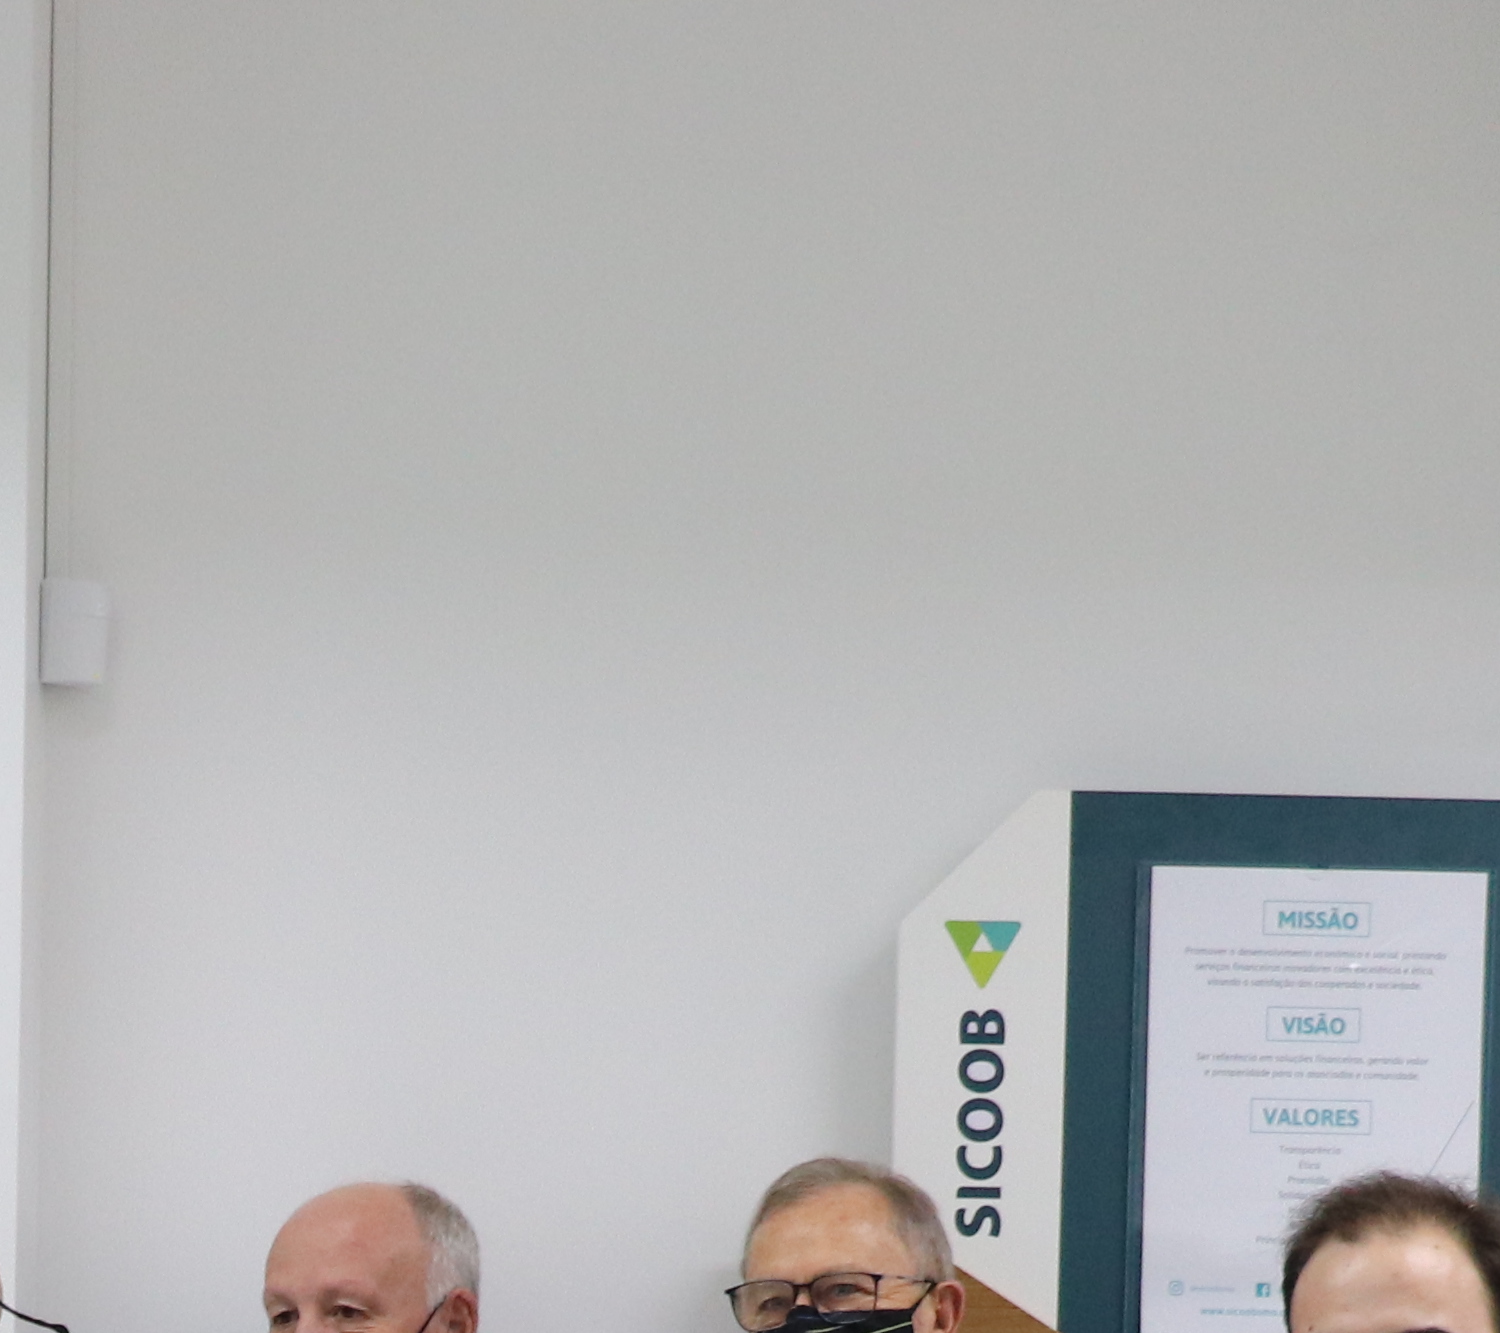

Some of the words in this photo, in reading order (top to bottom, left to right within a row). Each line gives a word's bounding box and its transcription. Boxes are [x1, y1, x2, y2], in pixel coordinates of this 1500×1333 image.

[1277, 907, 1359, 930] MISSÃO
[1282, 1012, 1347, 1035] VISÃO
[955, 1008, 1006, 1238] SICOOB
[1263, 1107, 1360, 1128] VALORES
